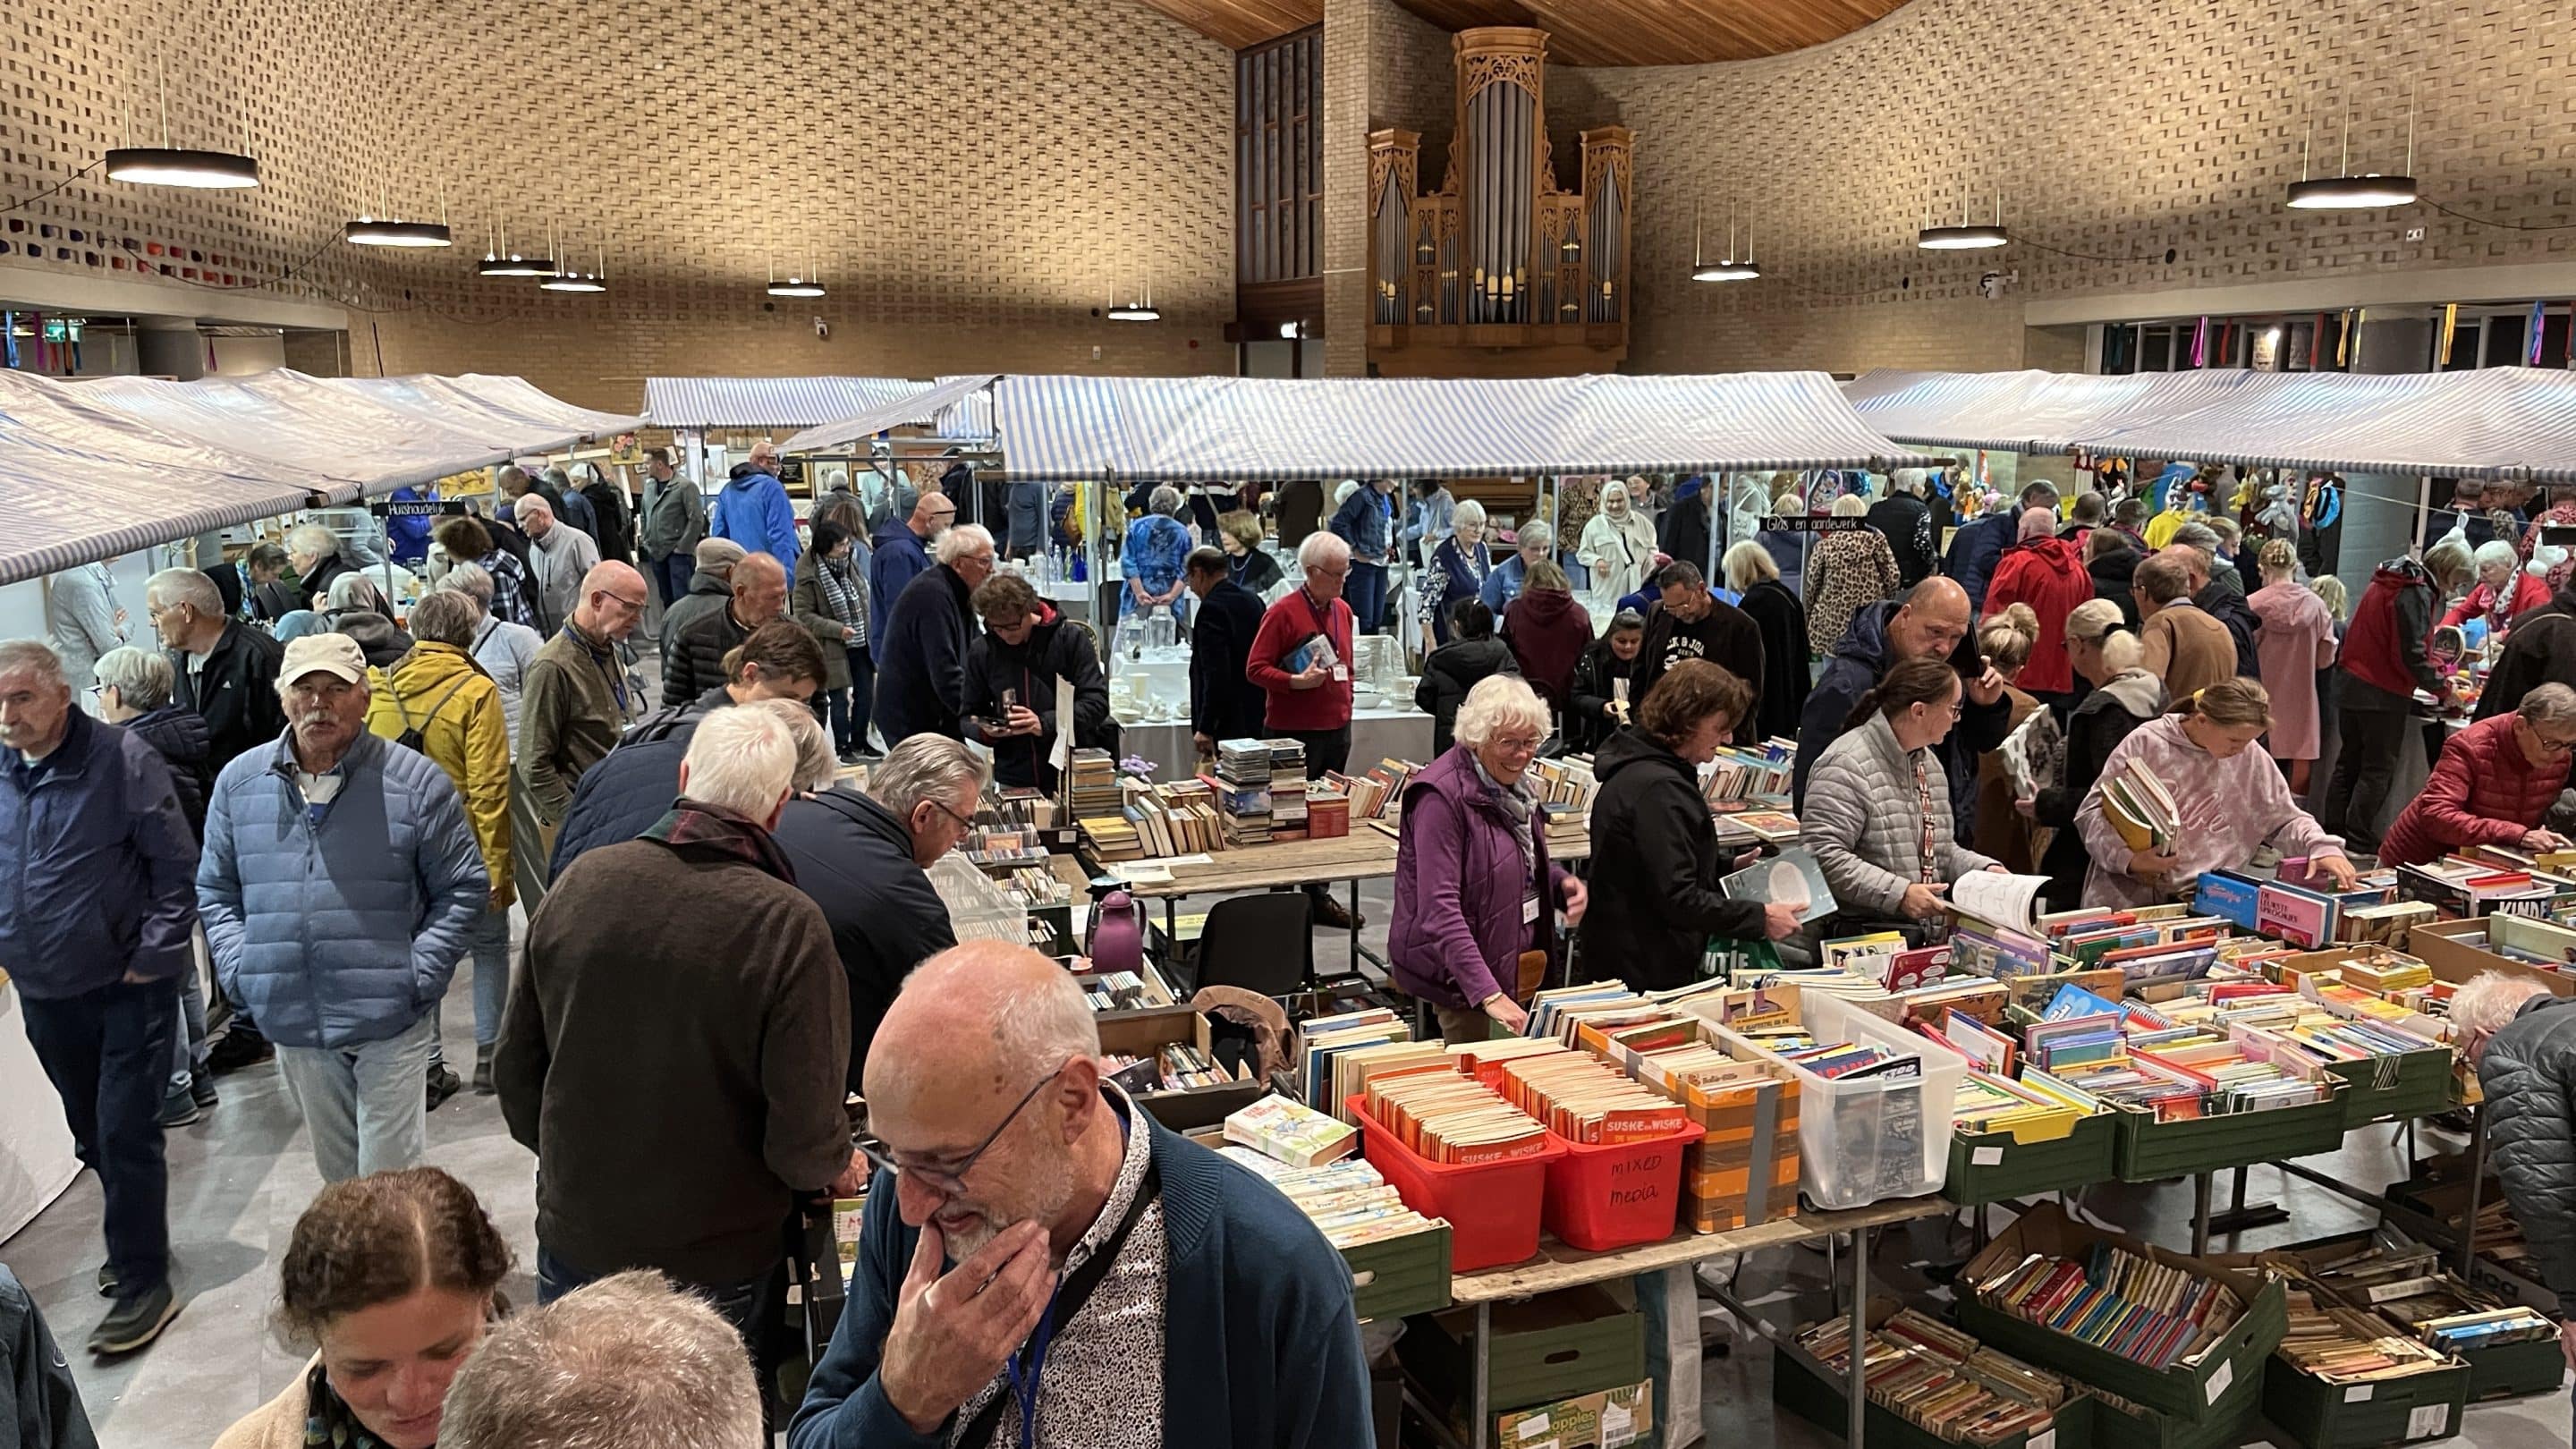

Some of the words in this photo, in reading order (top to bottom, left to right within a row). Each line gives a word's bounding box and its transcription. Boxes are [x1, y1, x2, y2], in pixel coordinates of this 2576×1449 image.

[1767, 517, 1789, 531] Glas
[1795, 521, 1807, 530] en
[1811, 517, 1857, 530] aardewerk
[1606, 1120, 1645, 1131] SUSKE
[1652, 1117, 1682, 1130] WISKE
[1461, 1151, 1503, 1165] SUSKE
[1551, 1411, 1596, 1432] apples
